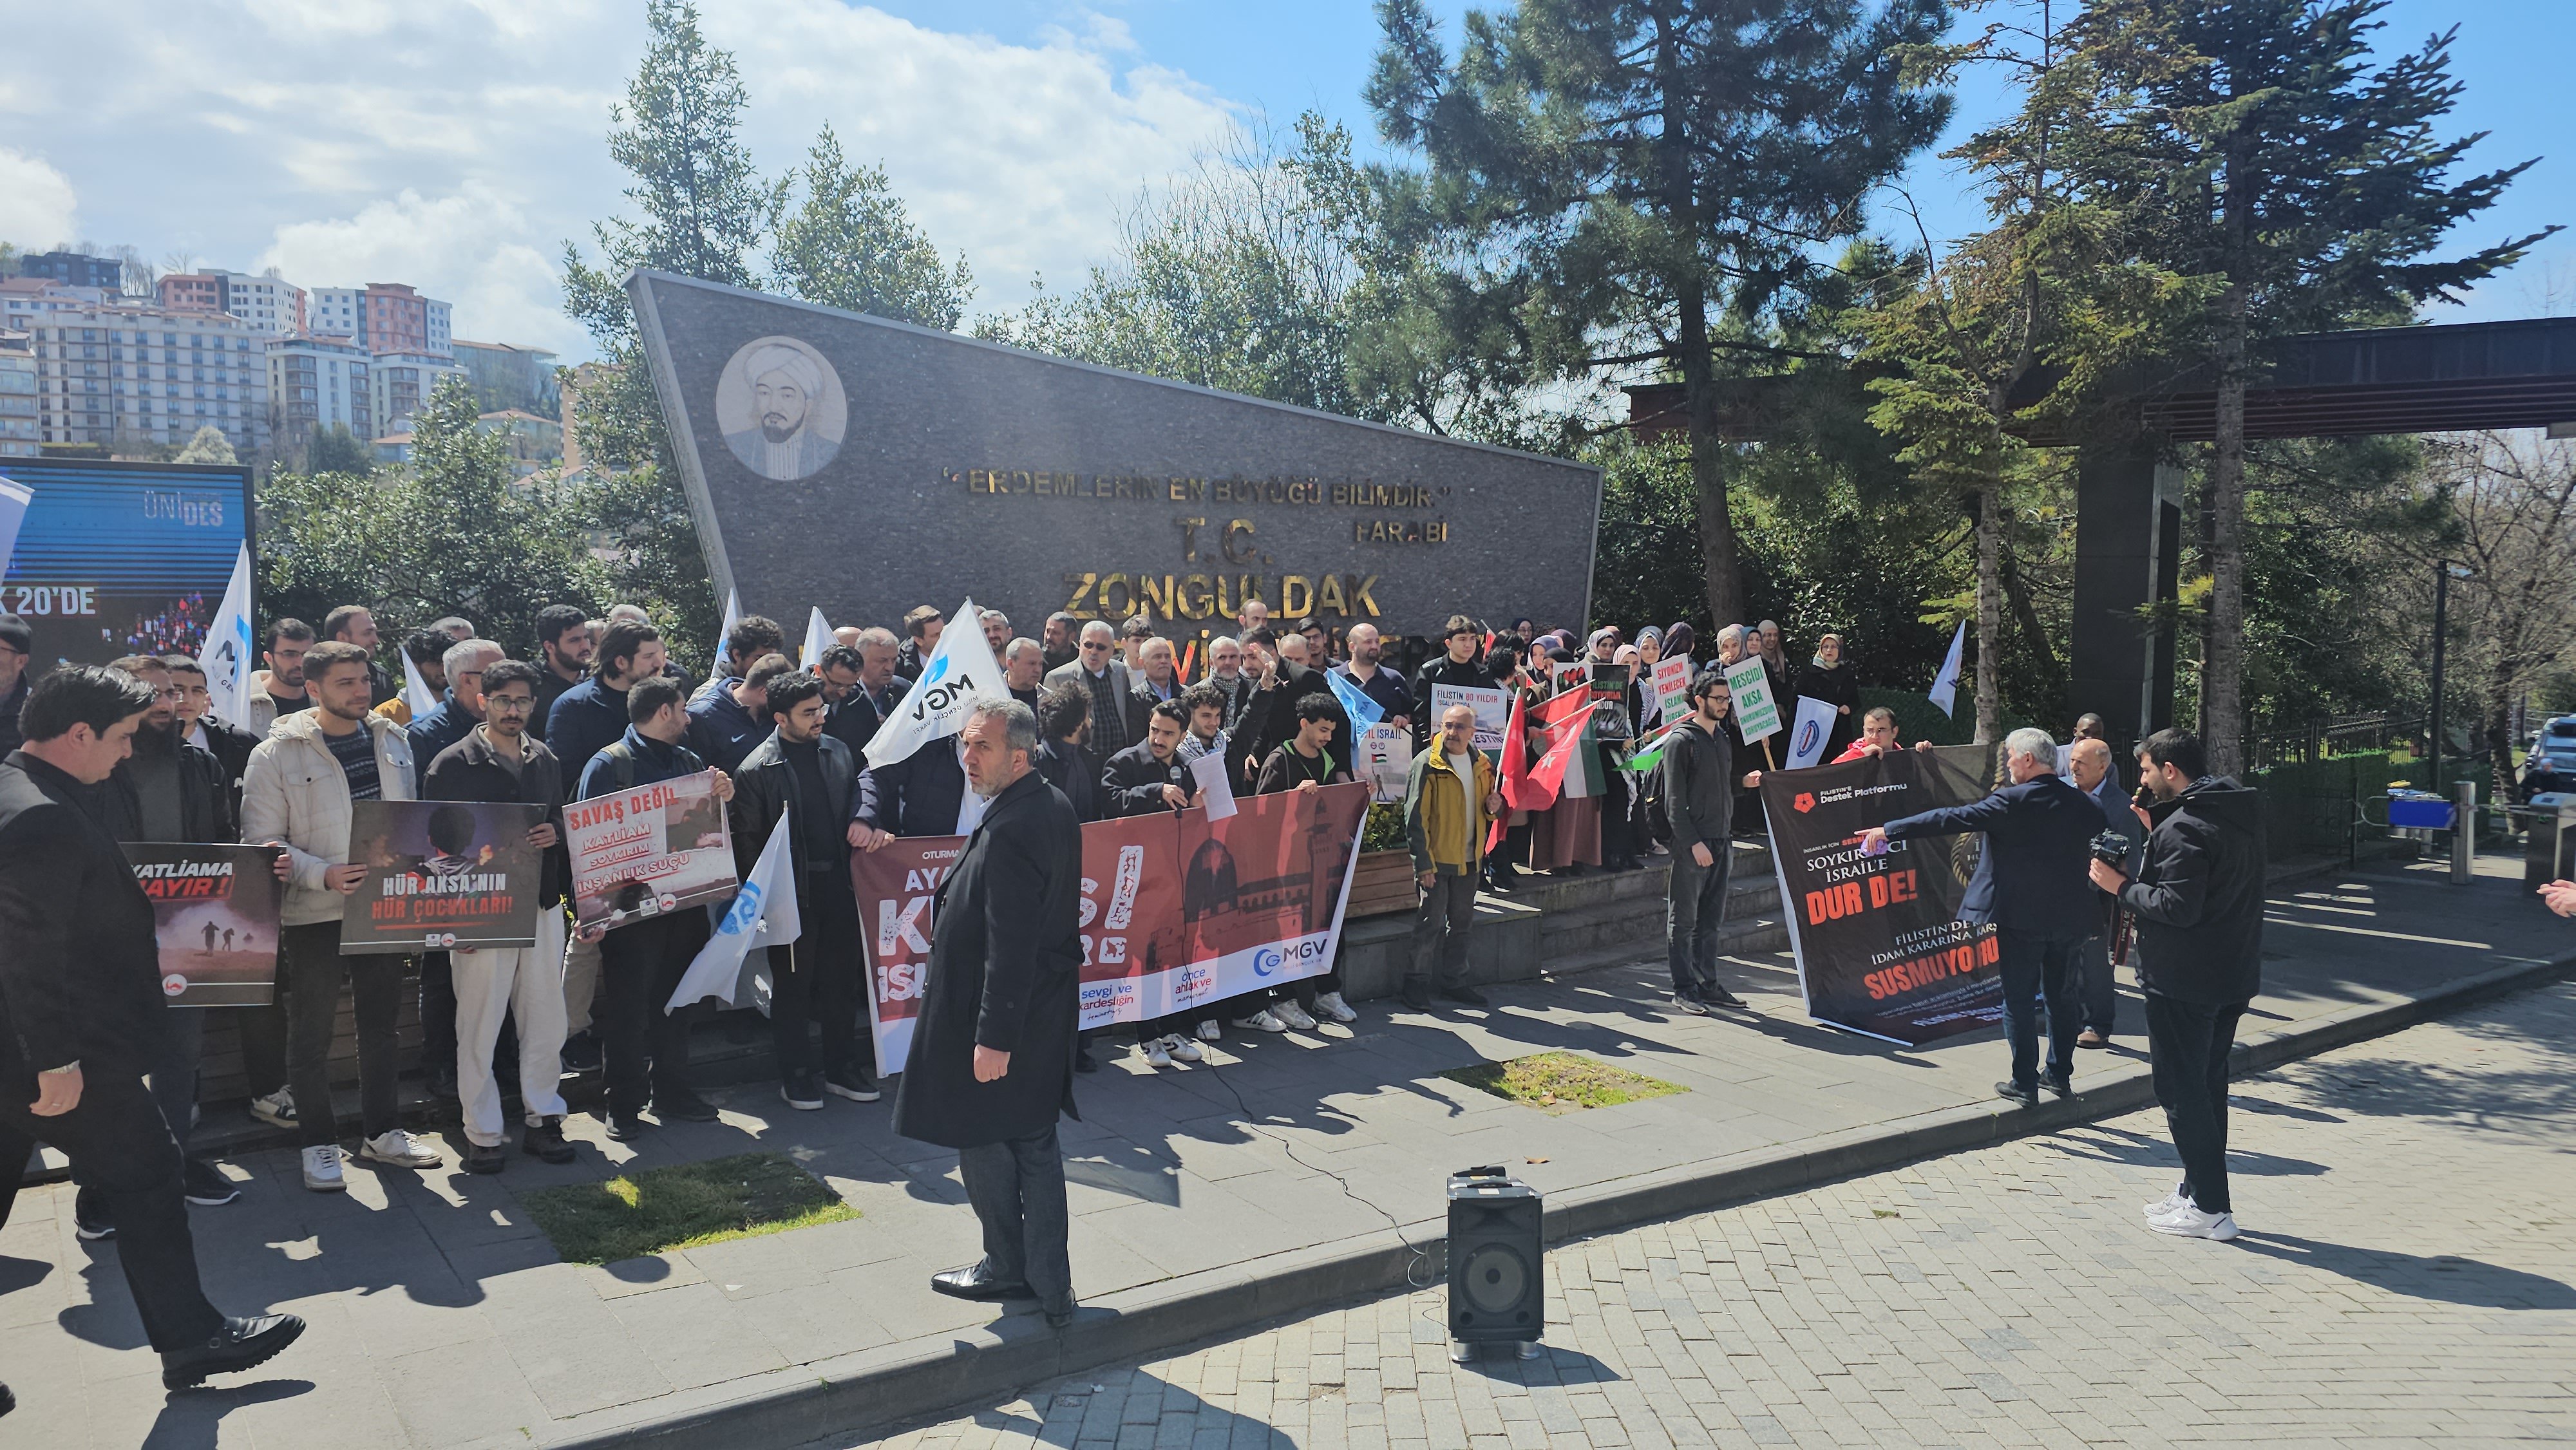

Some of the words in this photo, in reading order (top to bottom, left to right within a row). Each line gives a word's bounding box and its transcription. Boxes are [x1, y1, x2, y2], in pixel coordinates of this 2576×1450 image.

[1170, 476, 1205, 500] EN
[1215, 473, 1322, 505] BÜYÜĞÜ
[1175, 518, 1274, 565] T.C.
[16, 587, 96, 616] 20'DE
[1063, 574, 1381, 621] ZONGULDAK
[1741, 689, 1763, 709] AKSA
[569, 800, 625, 831] SAVAŞ
[630, 785, 679, 815] DEĞİL
[1820, 791, 1853, 804] Destek
[1854, 784, 1908, 798] Platformu
[583, 823, 651, 851] KATLİAM
[590, 843, 650, 867] SOYKIRIM
[1807, 840, 1908, 872] SOYKIRCI
[383, 873, 418, 896] HÜR
[576, 864, 646, 894] İNSANLIK
[649, 853, 690, 873] SUÇU
[1825, 858, 1888, 883] İSRAİL'E
[371, 898, 406, 919] HÜR
[1806, 881, 1863, 926] DUR
[1869, 869, 1918, 909] DE!
[1283, 938, 1327, 963] MGV
[1871, 949, 1905, 966] İDAM
[1907, 929, 1973, 955] KARARINA
[1864, 936, 2000, 1000] SUSMUYORU
[1081, 984, 1113, 999] sevgi
[1118, 984, 1132, 994] ve
[1175, 981, 1199, 995] ahlak
[1200, 977, 1211, 987] ve
